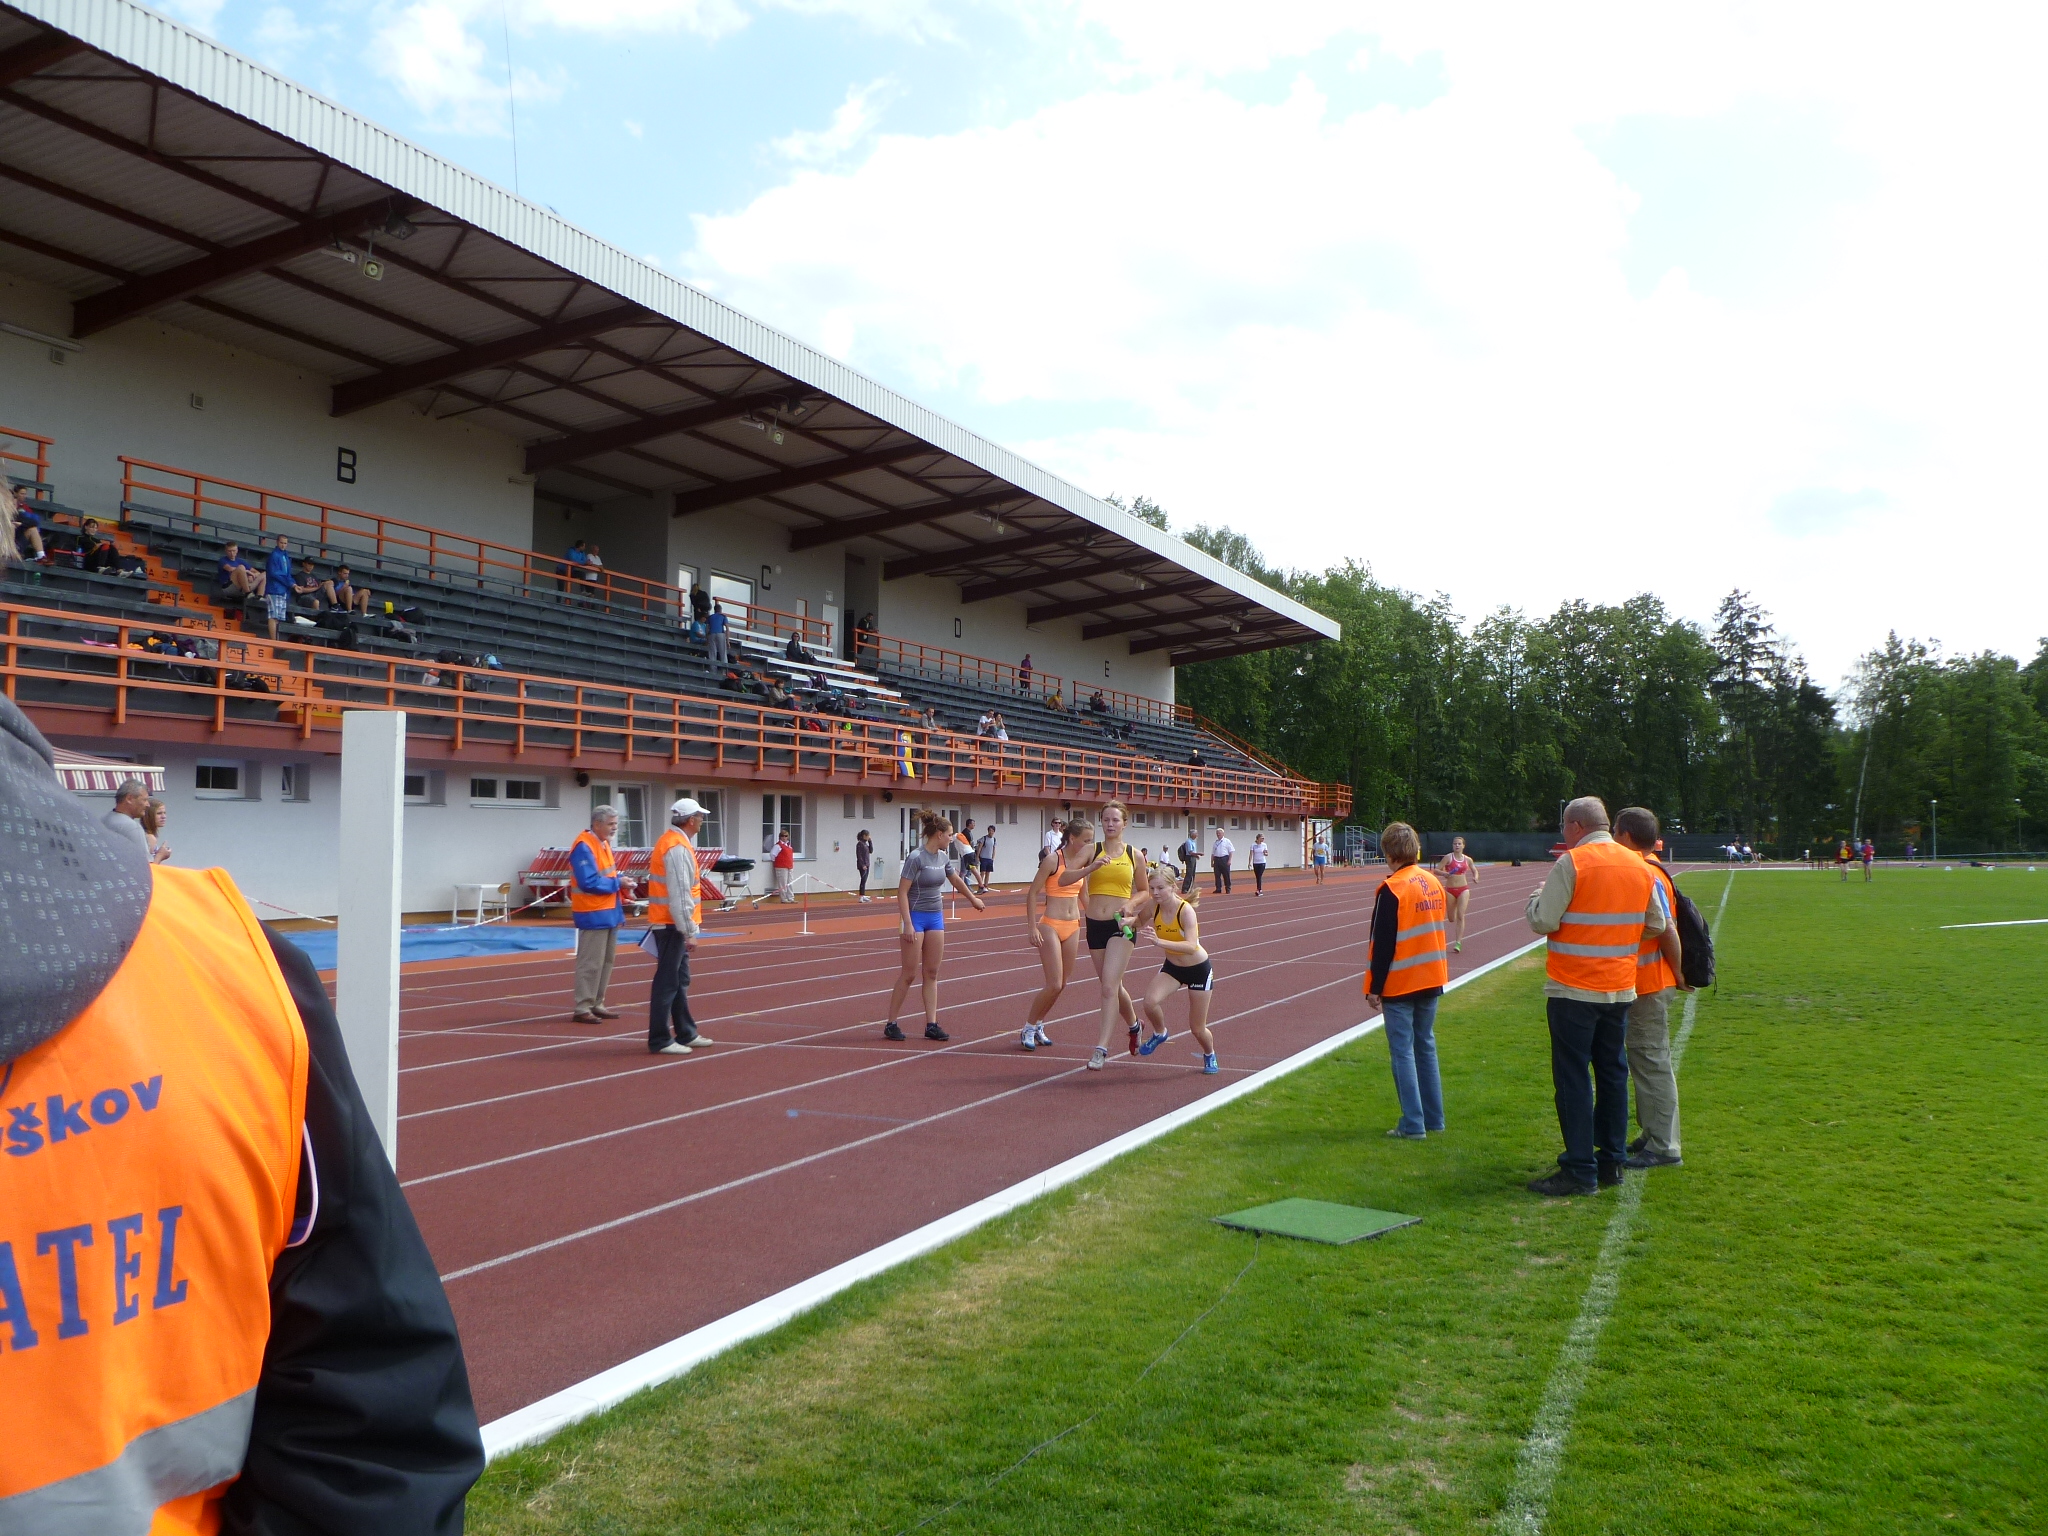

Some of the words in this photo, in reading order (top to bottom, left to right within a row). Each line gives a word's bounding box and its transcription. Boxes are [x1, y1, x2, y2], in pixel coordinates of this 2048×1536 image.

[337, 446, 357, 484] B
[761, 564, 772, 591] C
[194, 595, 201, 604] 4
[225, 622, 232, 630] 5
[954, 617, 963, 639] D
[1104, 660, 1110, 678] E
[0, 1074, 163, 1158] škov
